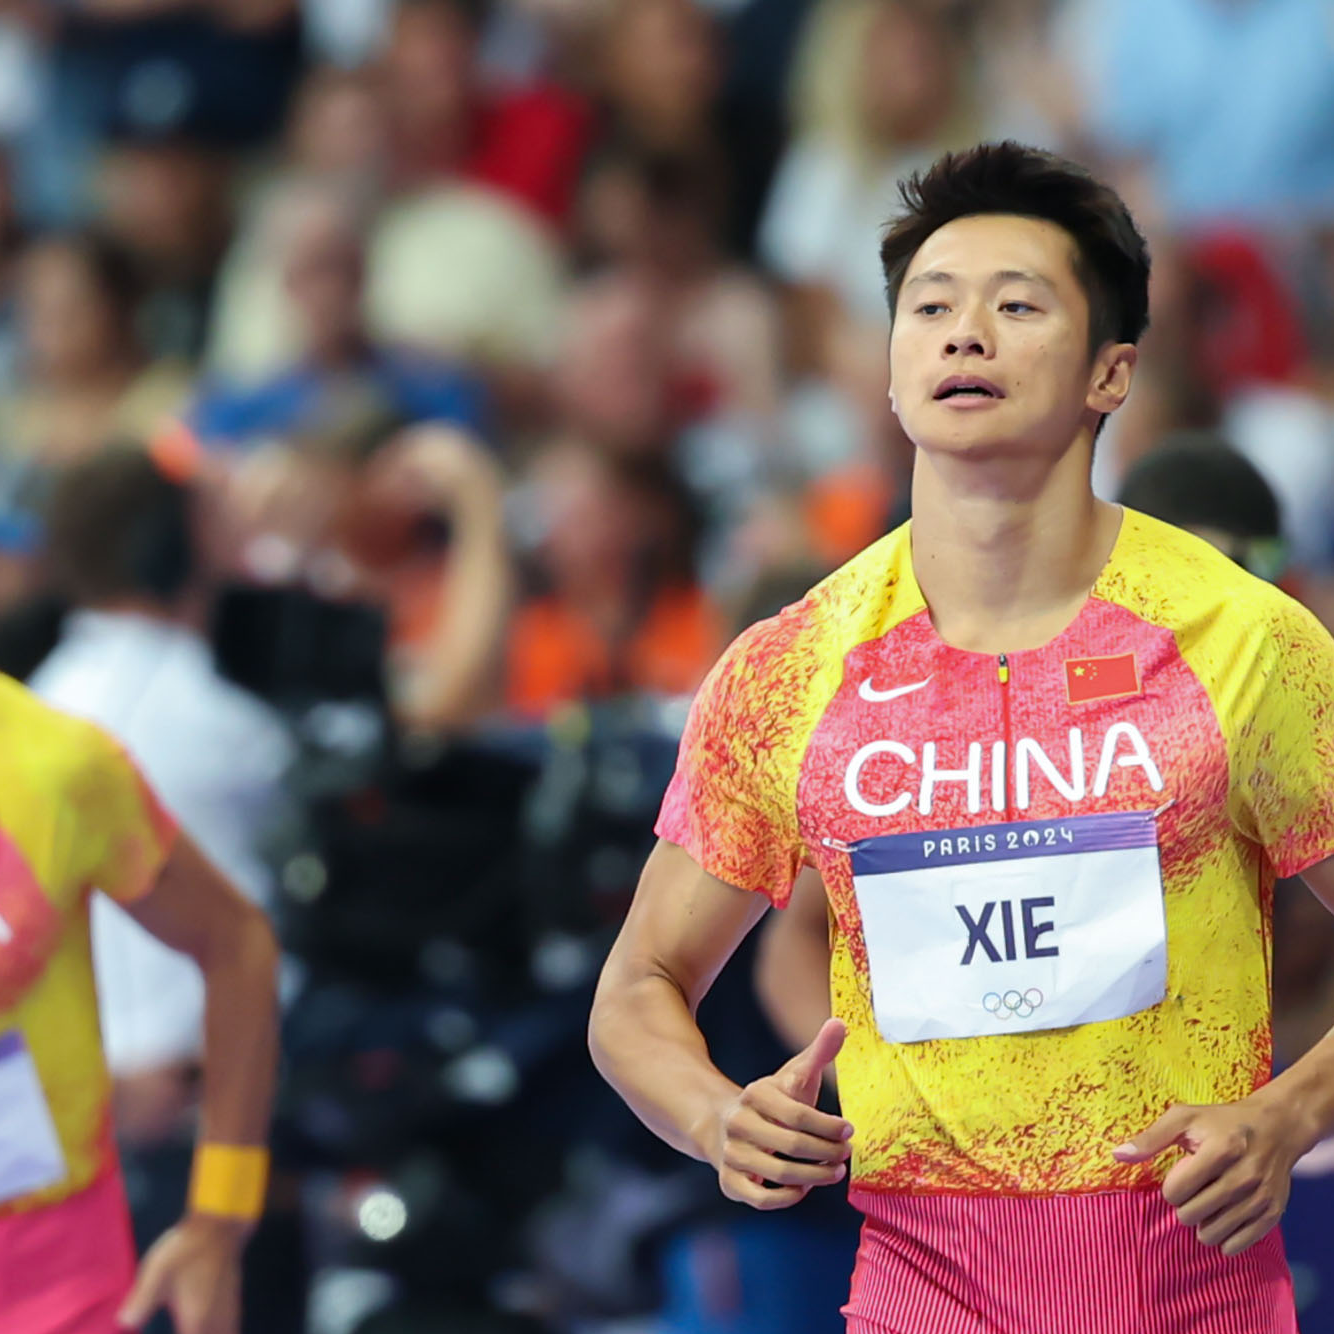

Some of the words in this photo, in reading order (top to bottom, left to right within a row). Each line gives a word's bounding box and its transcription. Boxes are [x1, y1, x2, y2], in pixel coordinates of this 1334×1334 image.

[844, 722, 1162, 817] CHINA
[923, 834, 997, 859] PARIS
[1007, 827, 1074, 851] 2024
[956, 896, 1059, 966] XIE
